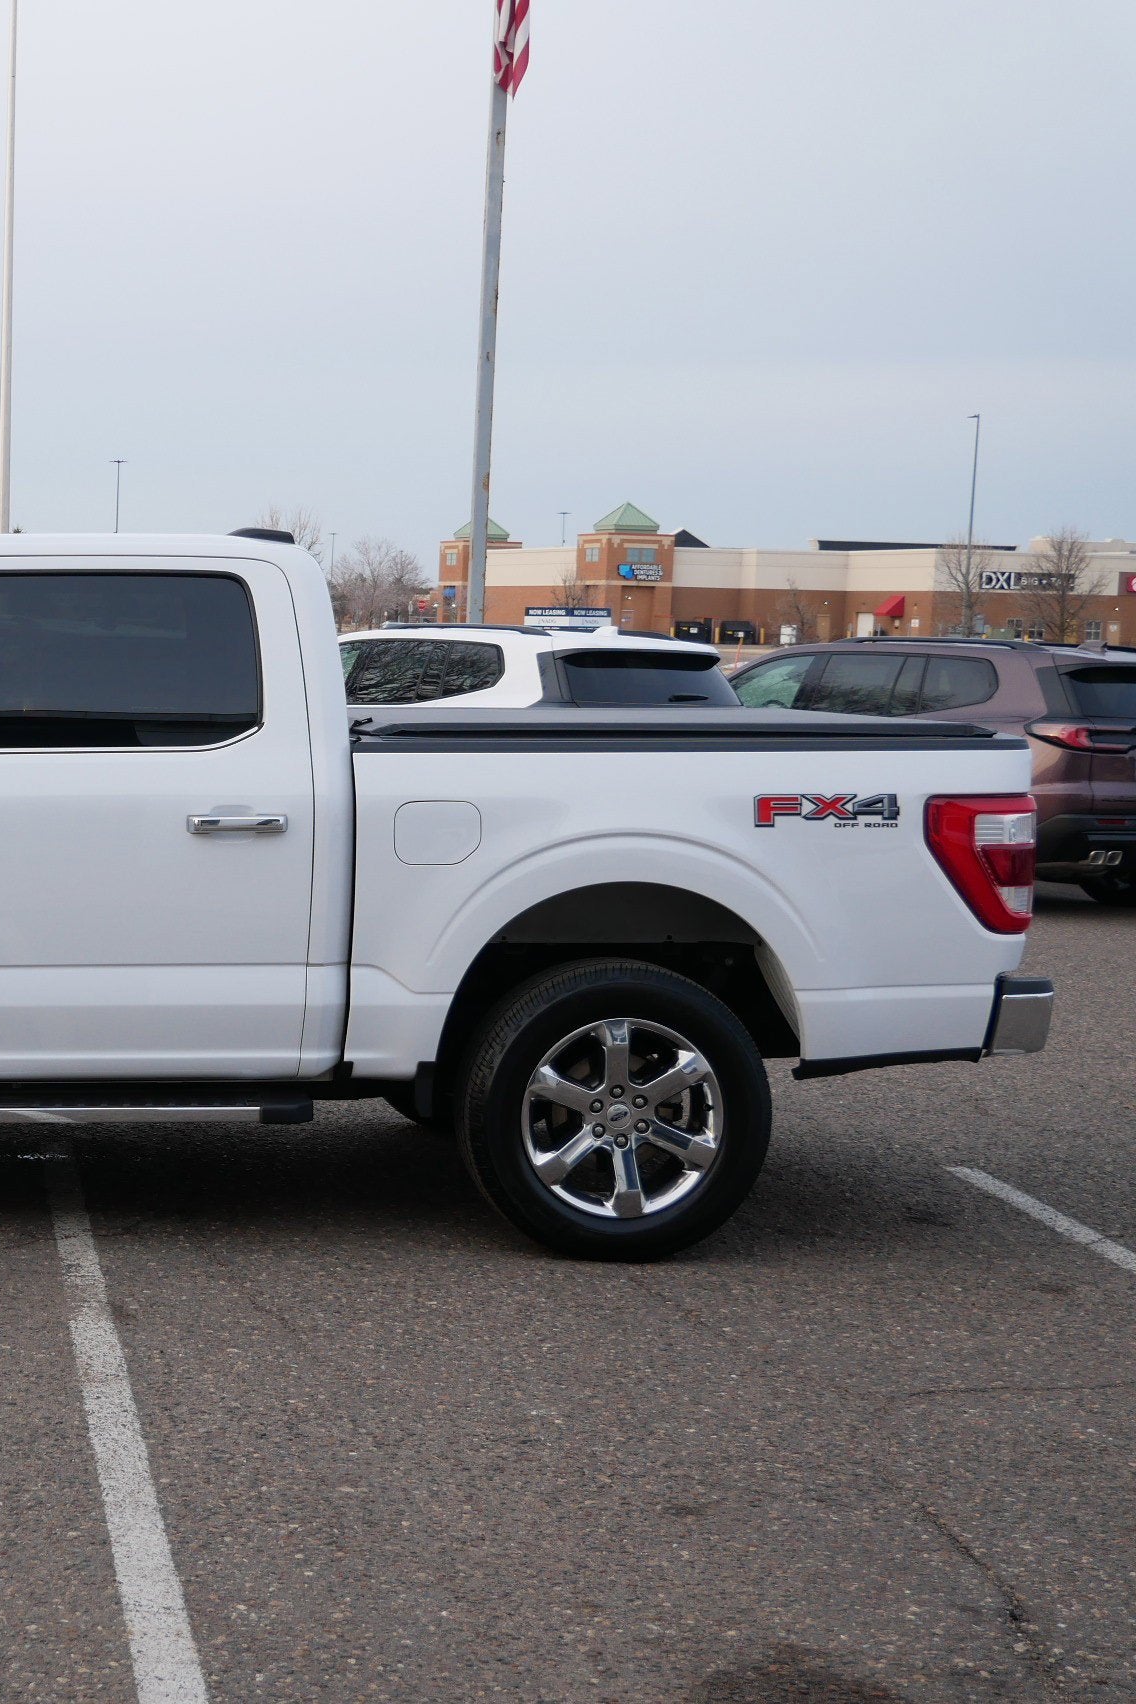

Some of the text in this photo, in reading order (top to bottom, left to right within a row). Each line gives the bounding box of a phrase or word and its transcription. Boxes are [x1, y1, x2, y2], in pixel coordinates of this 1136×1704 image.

[981, 571, 1021, 590] DXL
[542, 609, 567, 617] LEASING
[753, 793, 900, 828] FX4
